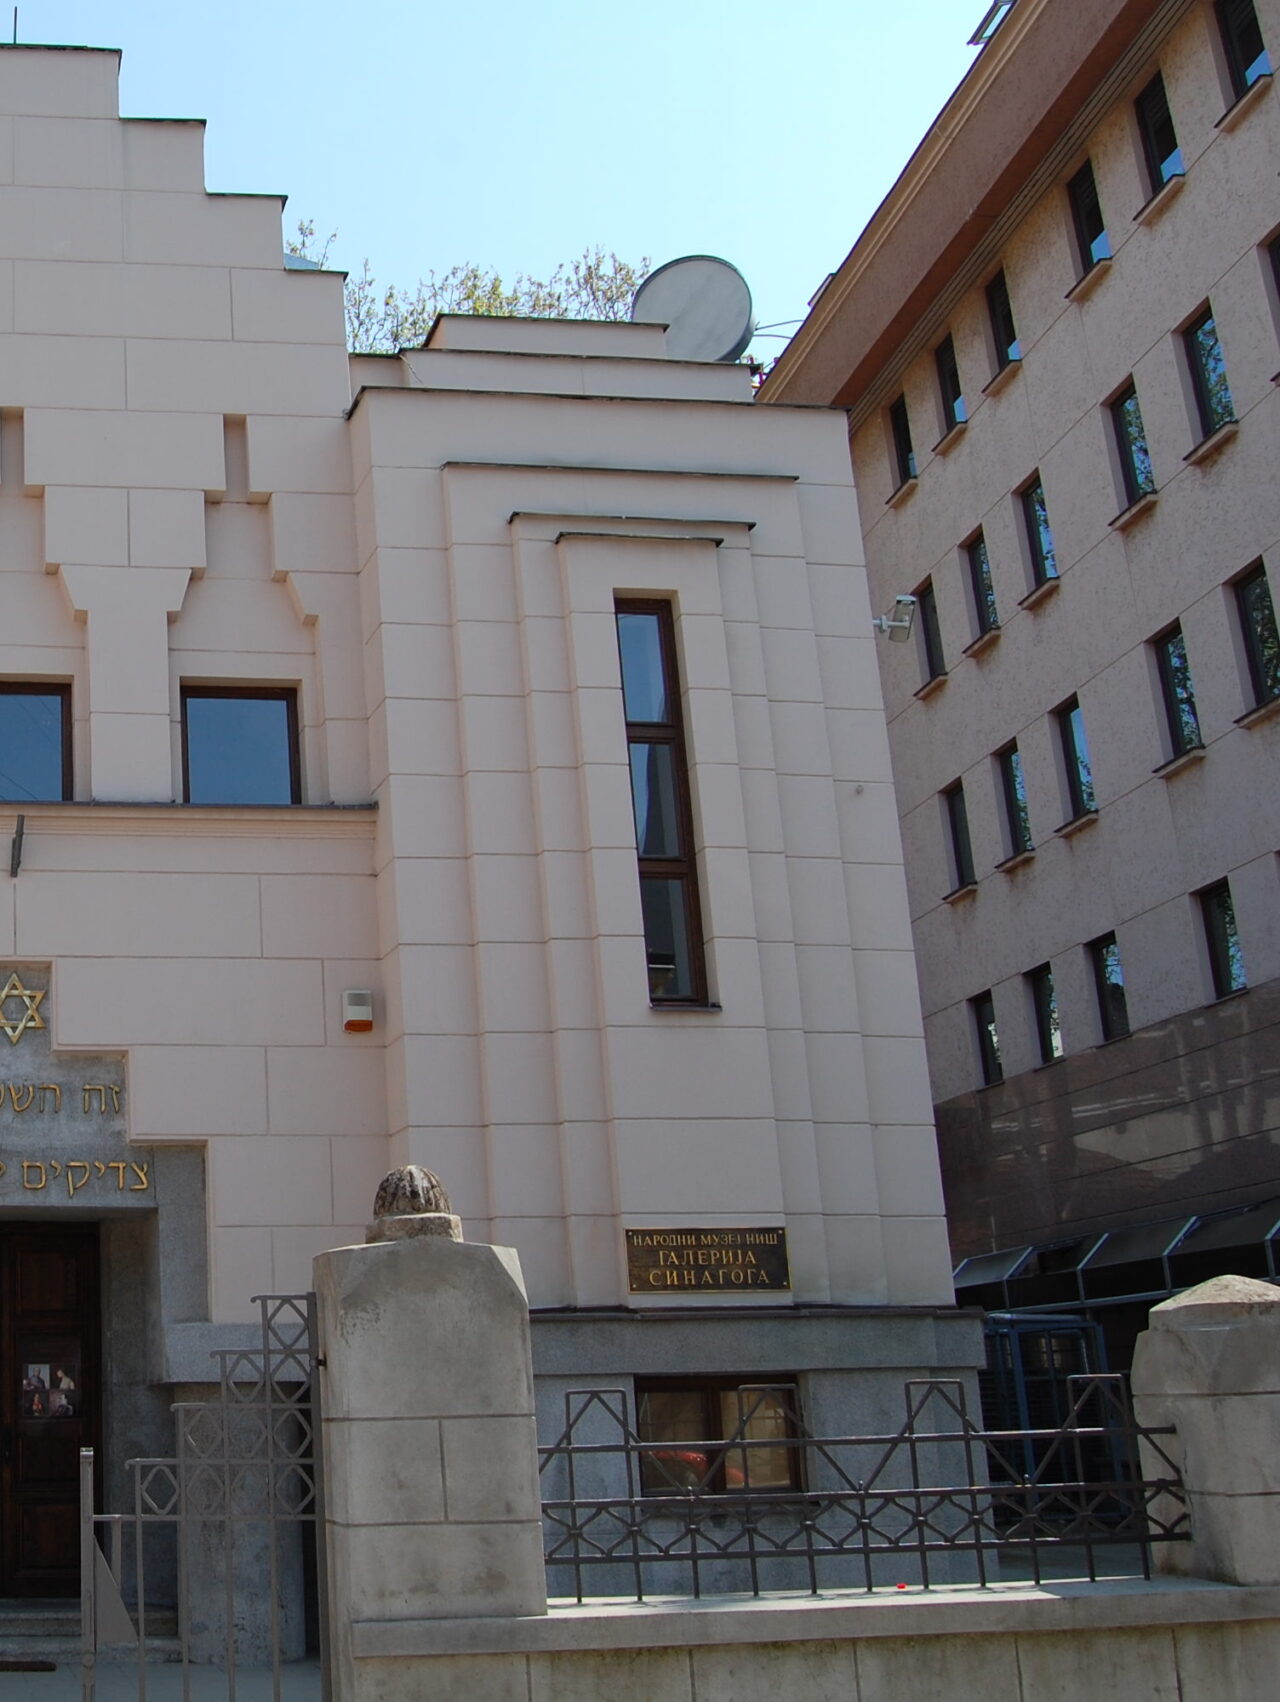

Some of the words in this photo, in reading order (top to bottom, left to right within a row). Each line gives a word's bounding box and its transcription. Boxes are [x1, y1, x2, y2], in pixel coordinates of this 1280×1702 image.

[82, 1083, 121, 1113] זה
[22, 1159, 149, 1198] צדיקים
[633, 1234, 696, 1246] НАРОДНИ
[700, 1233, 741, 1246] МУЗЕЈ
[746, 1233, 778, 1245] НИШ
[659, 1249, 757, 1266] ГАЛЕРИЈА
[649, 1268, 770, 1285] СИНАГОГА
